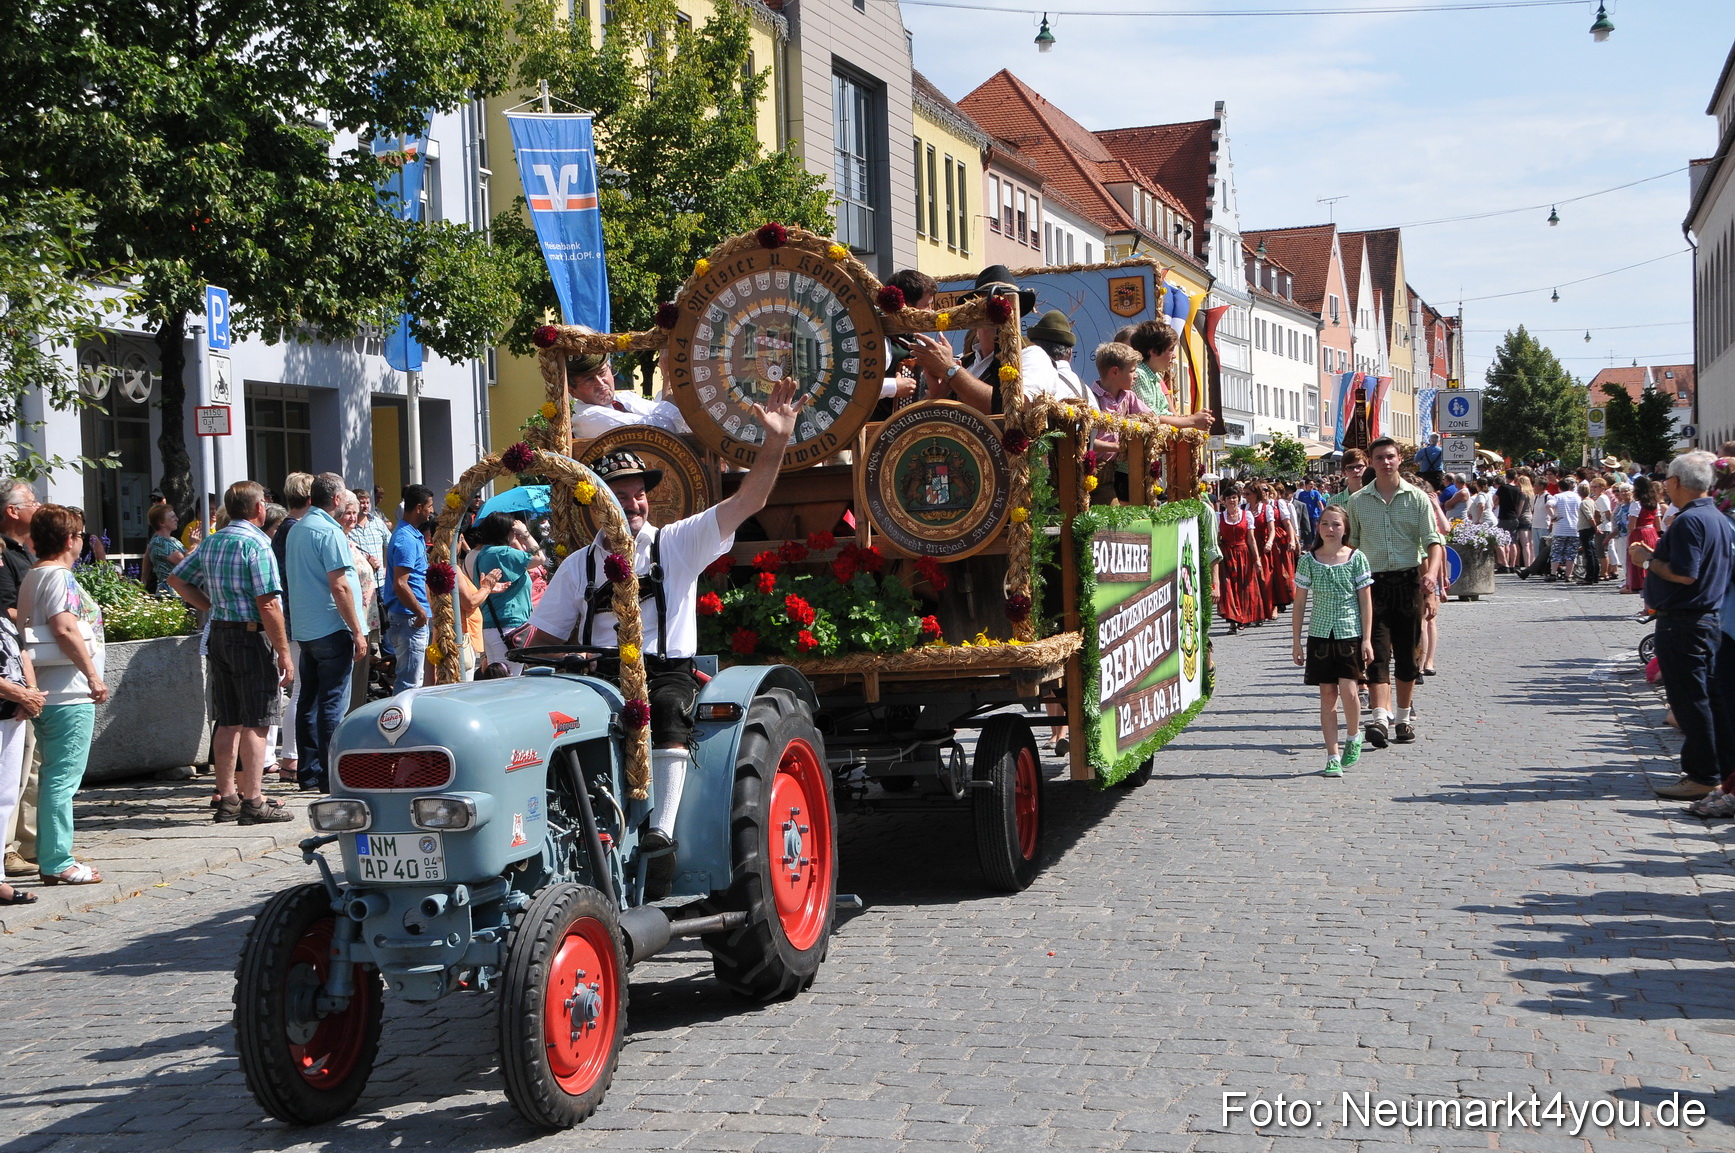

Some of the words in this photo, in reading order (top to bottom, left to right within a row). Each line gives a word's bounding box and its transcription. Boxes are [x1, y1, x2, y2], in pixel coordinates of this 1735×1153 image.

[686, 256, 755, 312] Meister
[770, 252, 786, 267] u.
[796, 255, 858, 305] Könige
[212, 295, 224, 341] P
[675, 336, 690, 390] 1964
[860, 327, 878, 381] 1988
[1448, 420, 1470, 428] ZONE
[720, 432, 838, 467] Tannwald
[1093, 540, 1109, 574] 50
[1110, 542, 1149, 575] JAHRE
[1099, 610, 1172, 704] BERNGAU
[369, 836, 397, 857] NM
[423, 857, 438, 866] 04
[365, 858, 389, 879] AP
[393, 858, 420, 879] 40
[425, 870, 439, 879] 09
